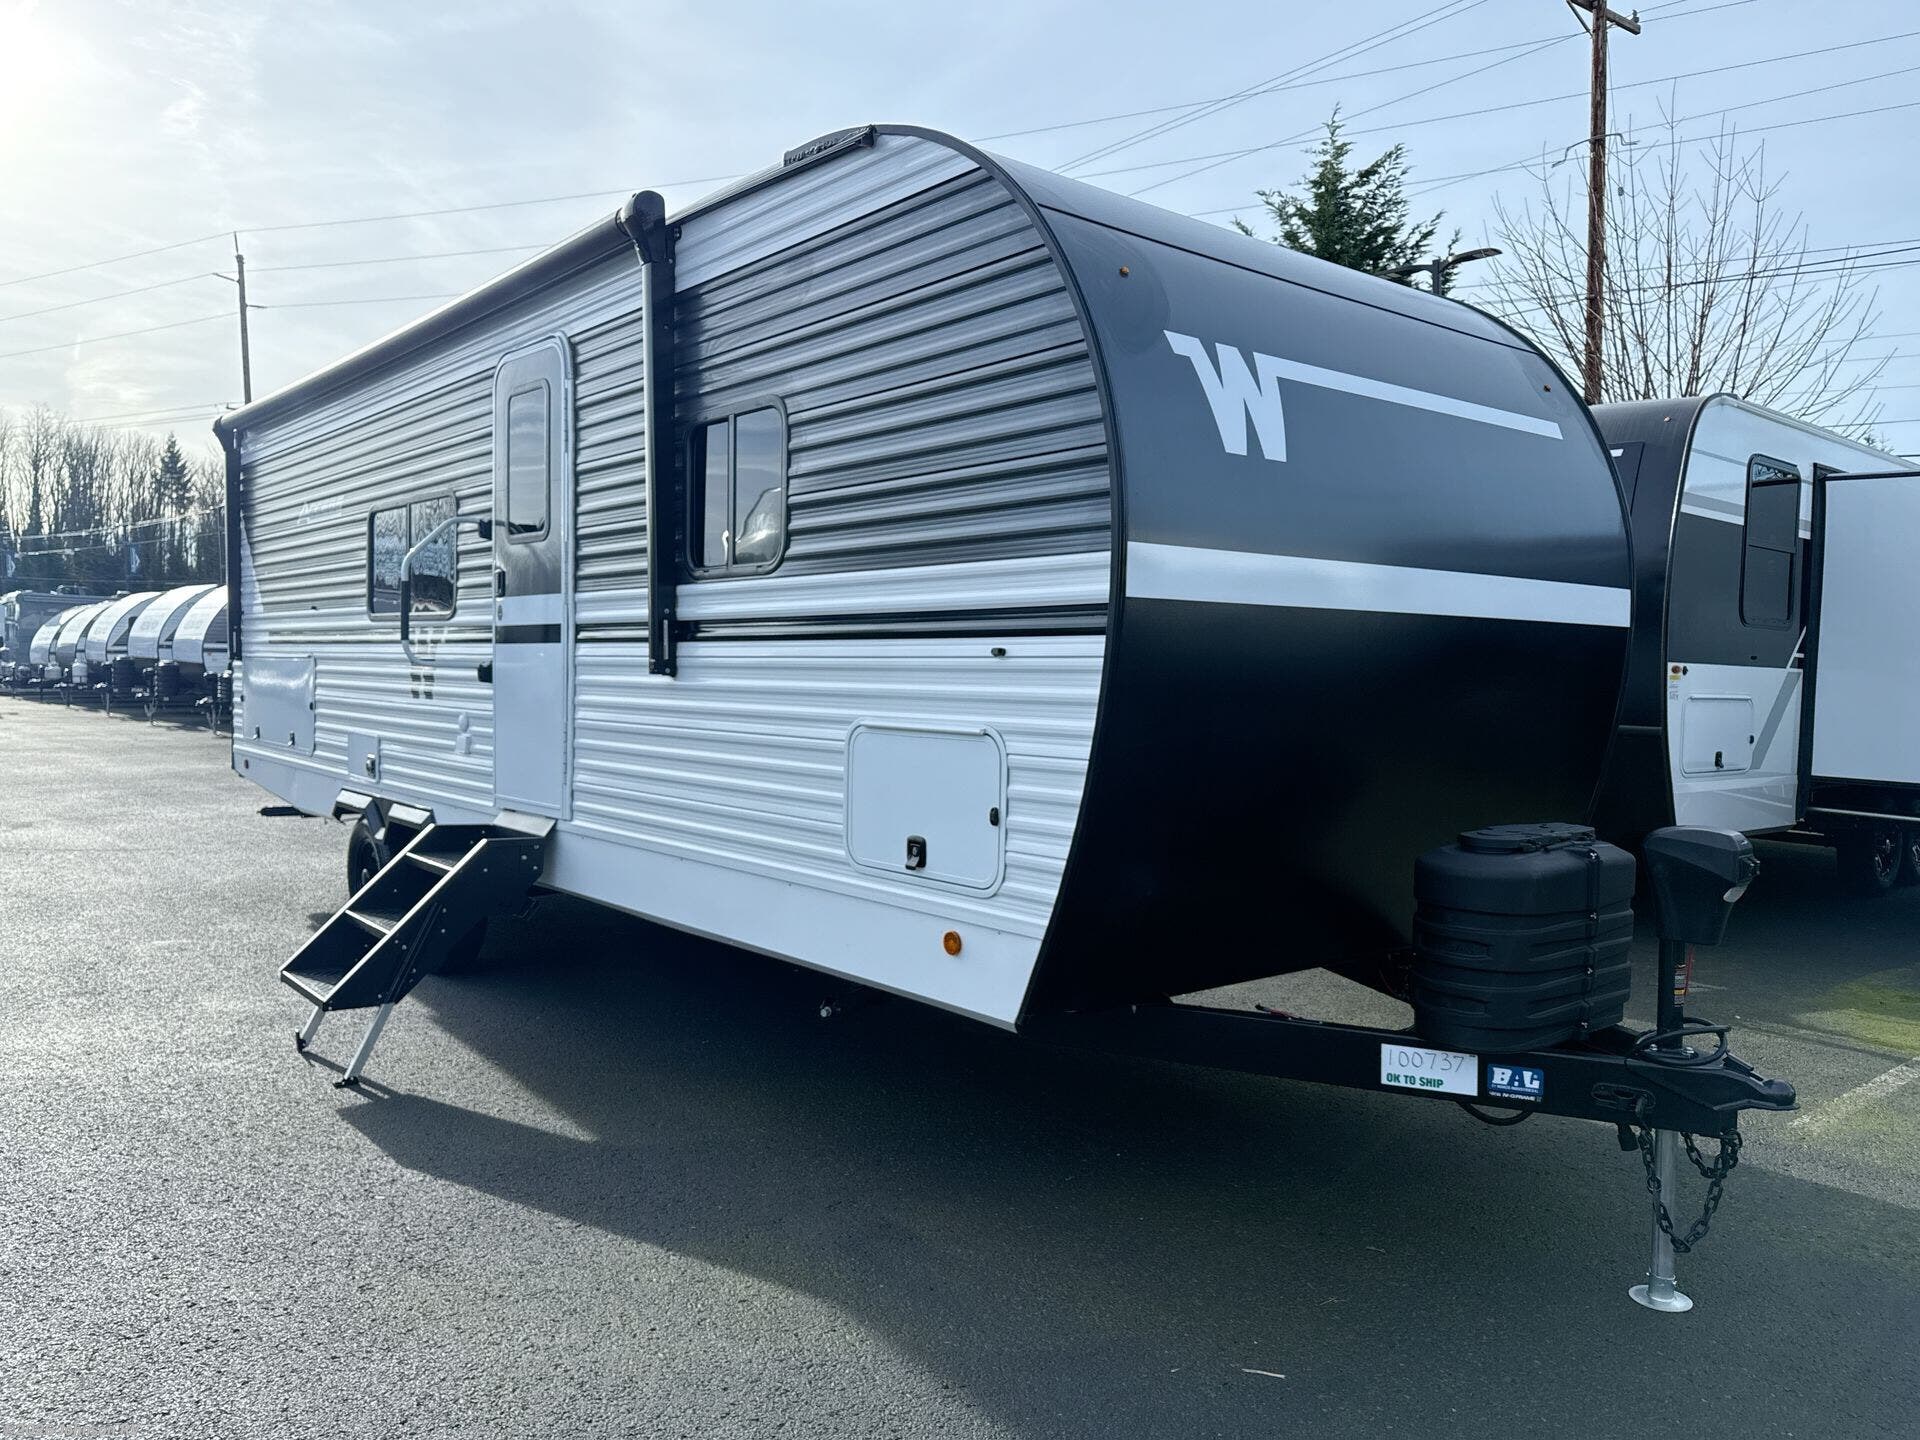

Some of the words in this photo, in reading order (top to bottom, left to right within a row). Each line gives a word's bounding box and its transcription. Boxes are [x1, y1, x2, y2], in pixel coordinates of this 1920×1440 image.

[1388, 1048, 1465, 1073] 100737
[1386, 1072, 1401, 1084] OK
[1403, 1074, 1416, 1086] TO
[1418, 1076, 1444, 1089] SHIP
[1491, 1066, 1541, 1089] BAL
